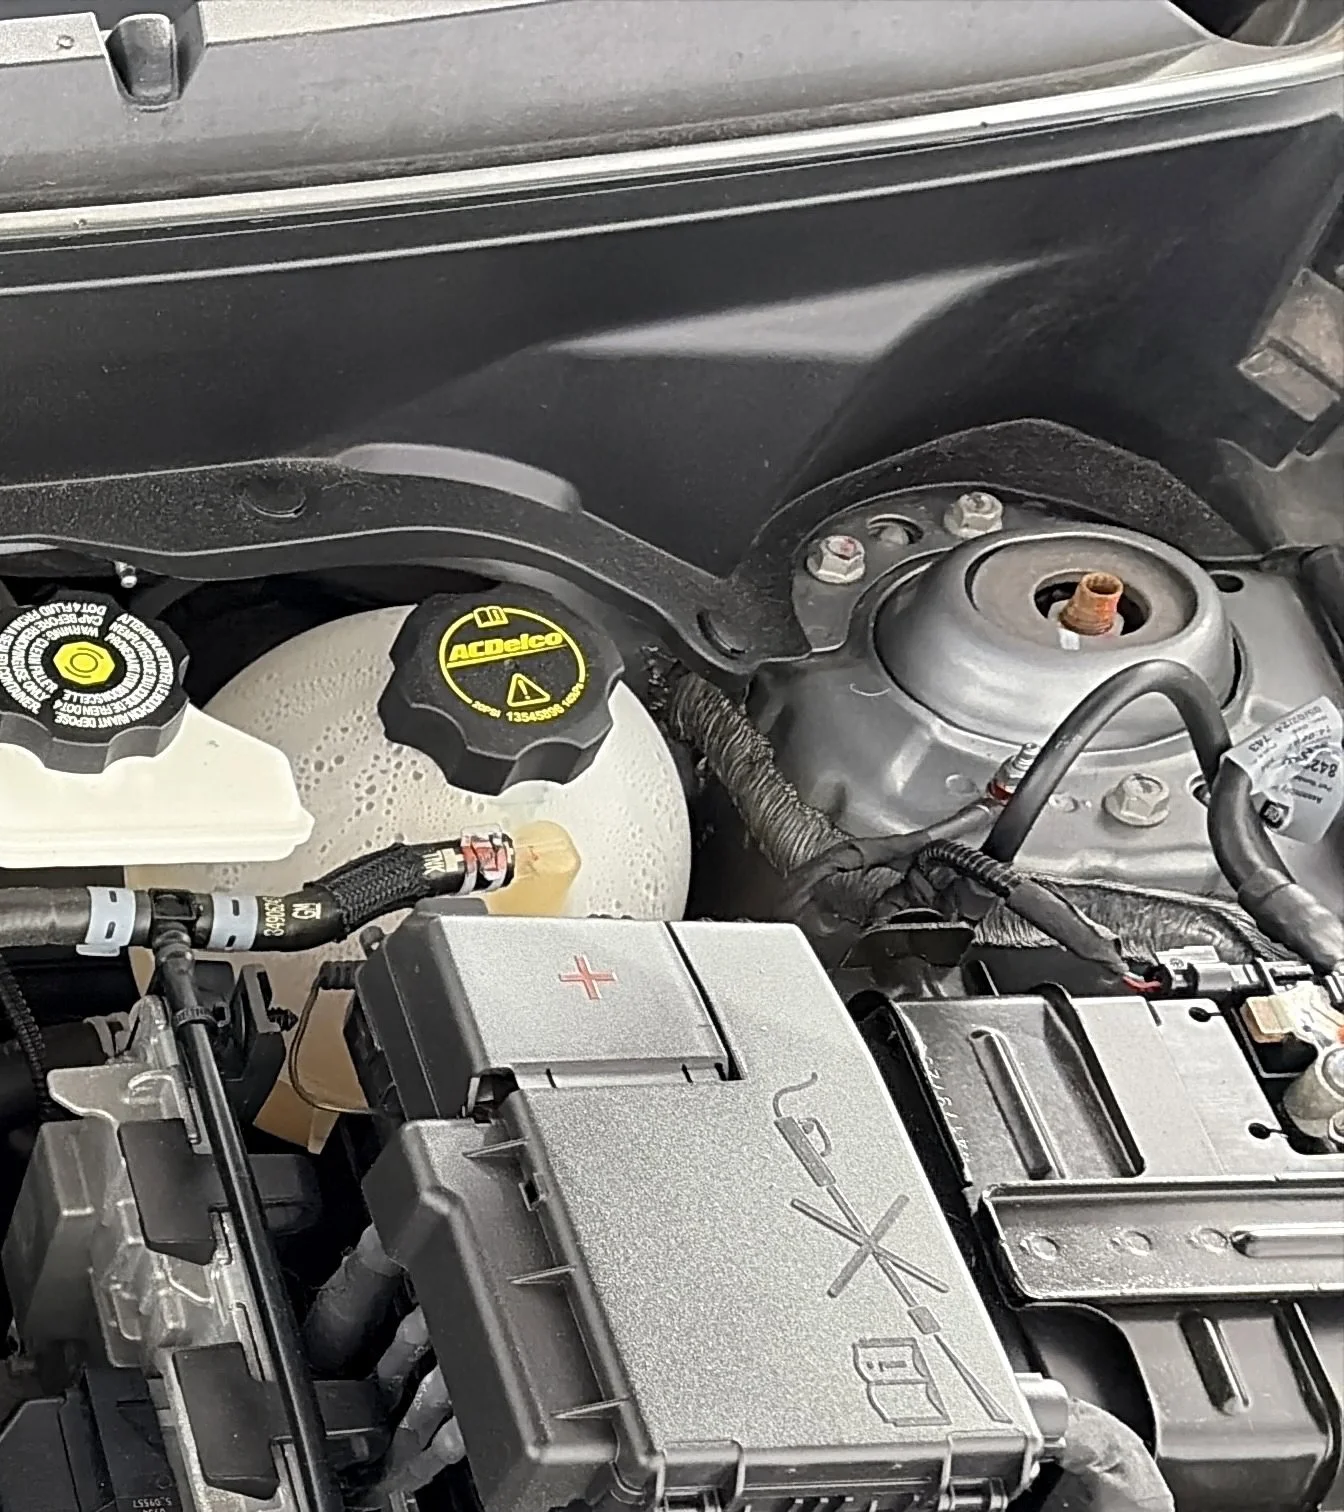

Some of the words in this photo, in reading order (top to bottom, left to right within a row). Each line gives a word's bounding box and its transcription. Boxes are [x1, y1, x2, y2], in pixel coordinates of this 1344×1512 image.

[34, 613, 77, 631] BEFORE
[77, 613, 103, 626] CAP
[449, 632, 563, 661] ACDelco
